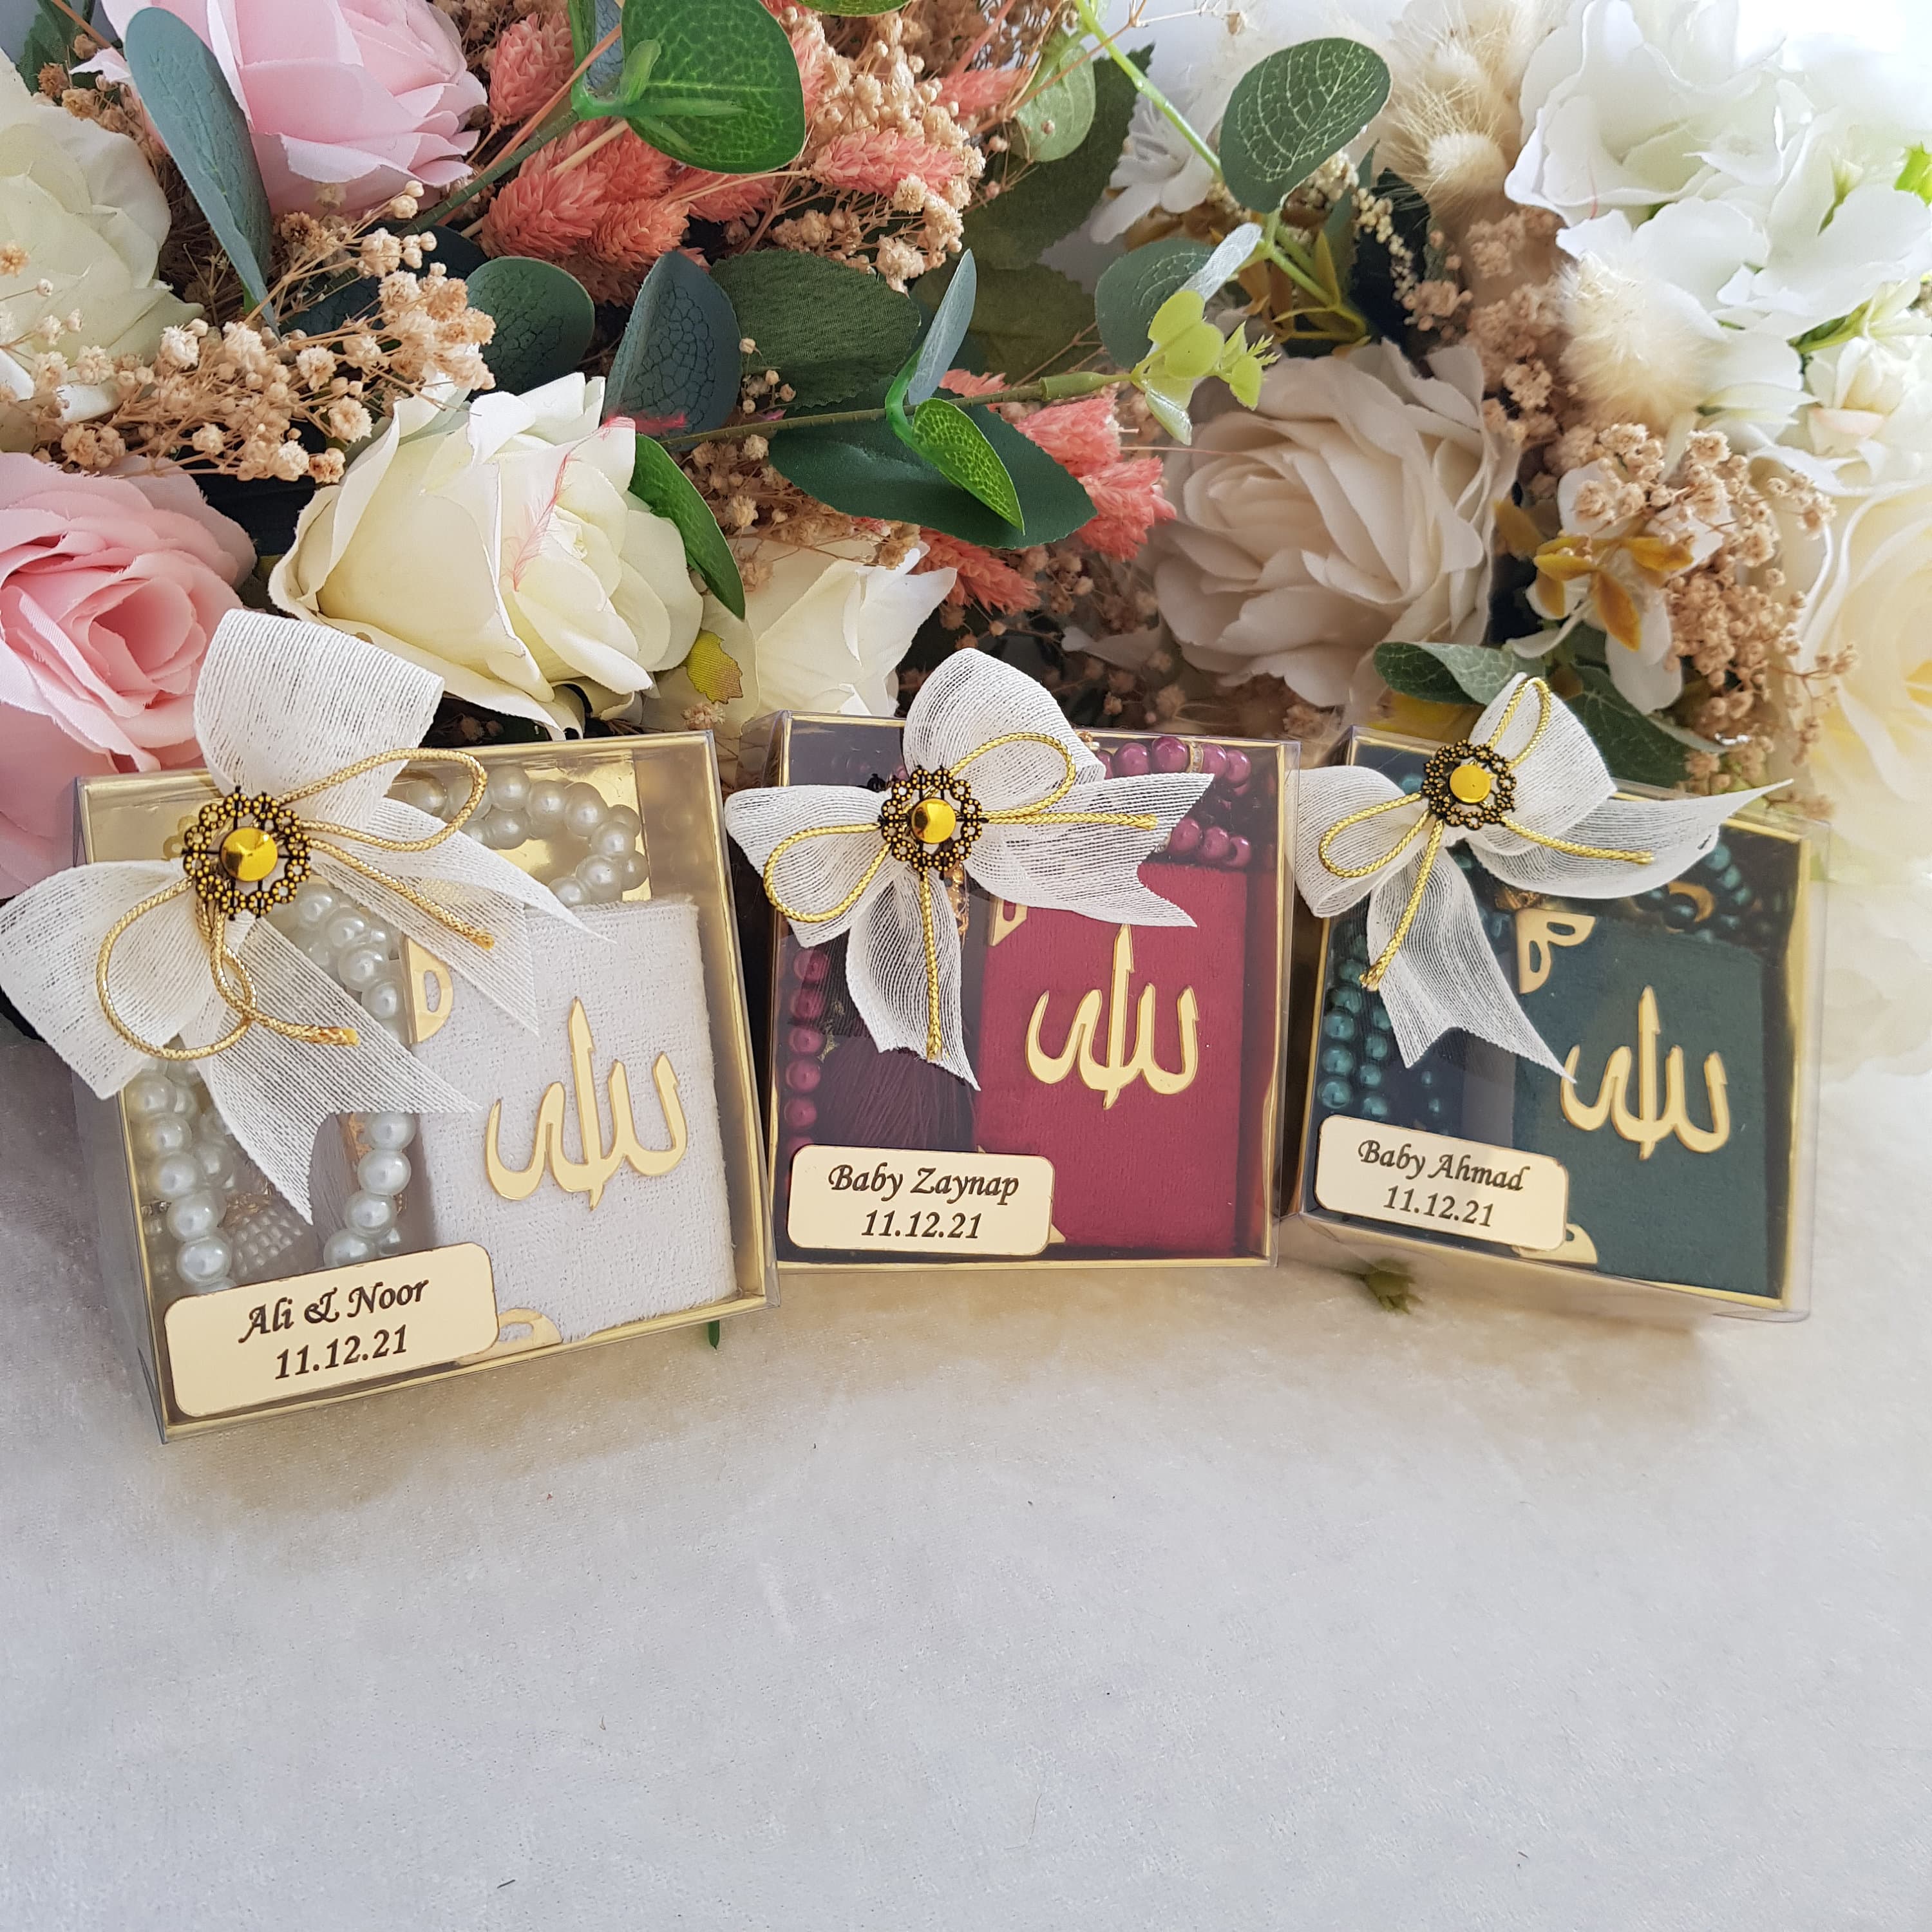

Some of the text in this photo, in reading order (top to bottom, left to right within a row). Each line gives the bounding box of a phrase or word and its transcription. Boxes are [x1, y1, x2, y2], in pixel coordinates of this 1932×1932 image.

[828, 1162, 1019, 1206] Baby Zaynap
[1358, 1139, 1531, 1191] Baby Ahmad
[861, 1209, 982, 1238] 11.12.21
[1383, 1185, 1494, 1227] 11.12.21
[238, 1279, 430, 1343] Ali & Noor
[275, 1324, 407, 1379] 11.12.21
